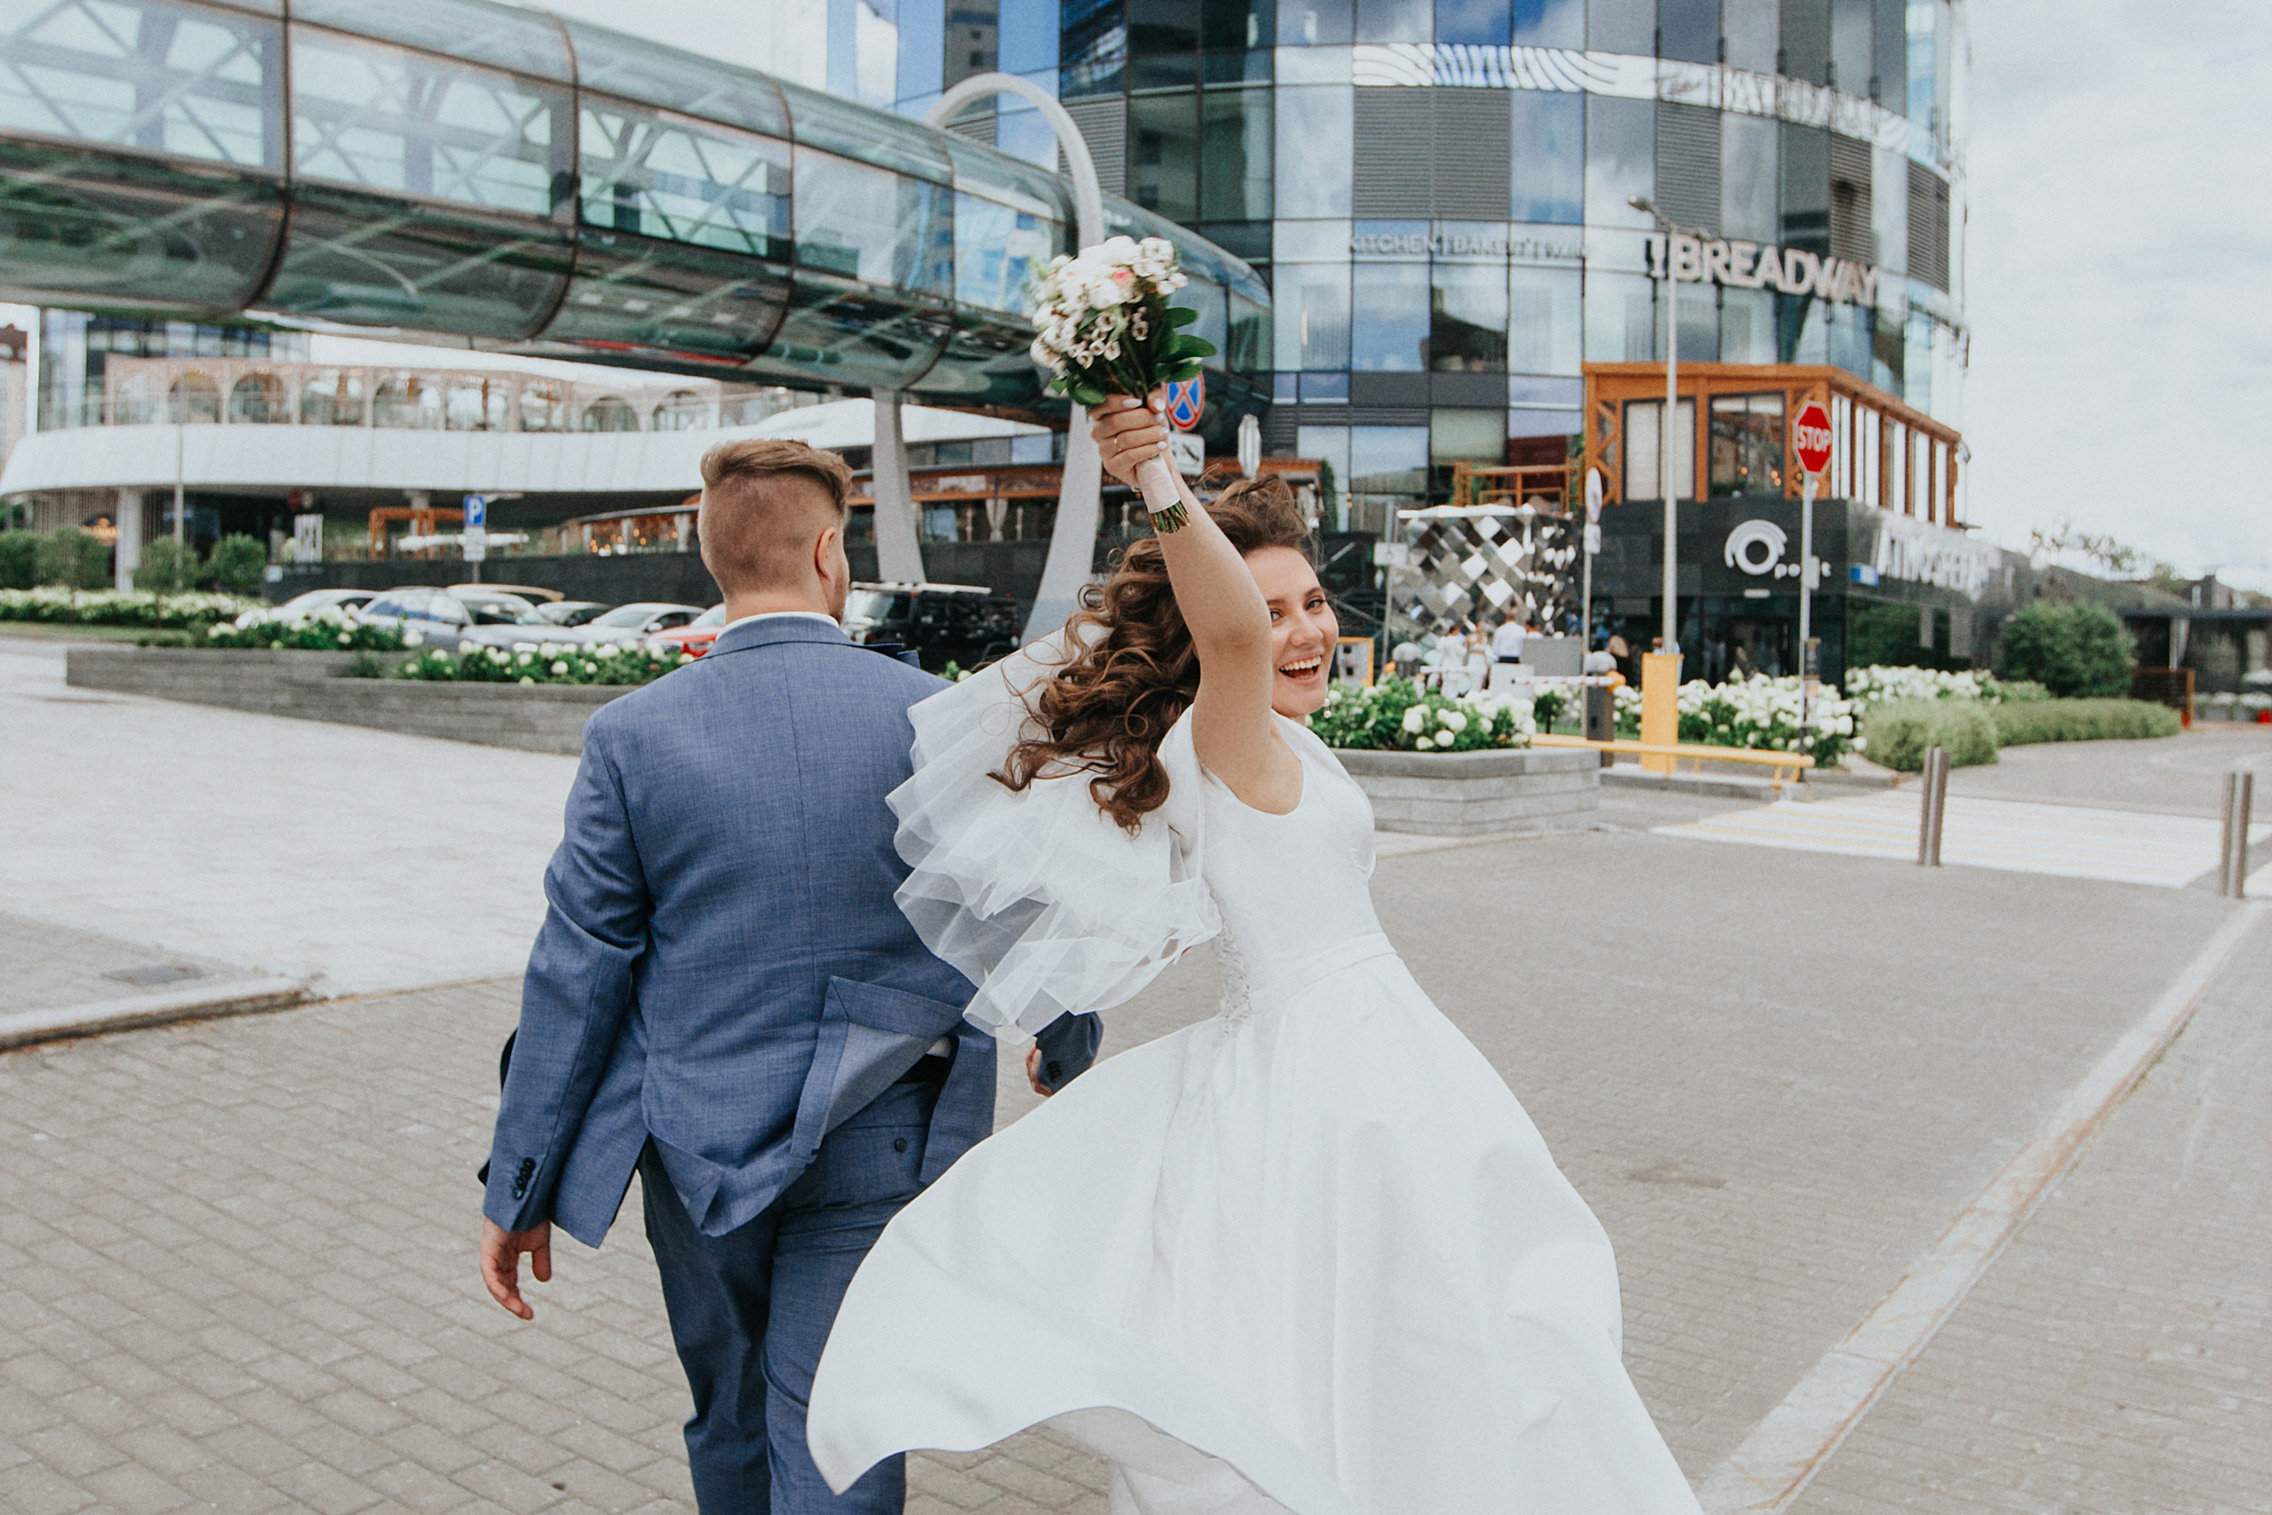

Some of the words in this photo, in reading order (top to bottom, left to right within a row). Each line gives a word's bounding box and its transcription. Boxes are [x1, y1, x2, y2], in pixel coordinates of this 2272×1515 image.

[1348, 234, 1438, 254] KITCHEN
[1670, 233, 1878, 308] BREADWAY
[1797, 424, 1833, 453] STOP
[467, 497, 483, 524] P
